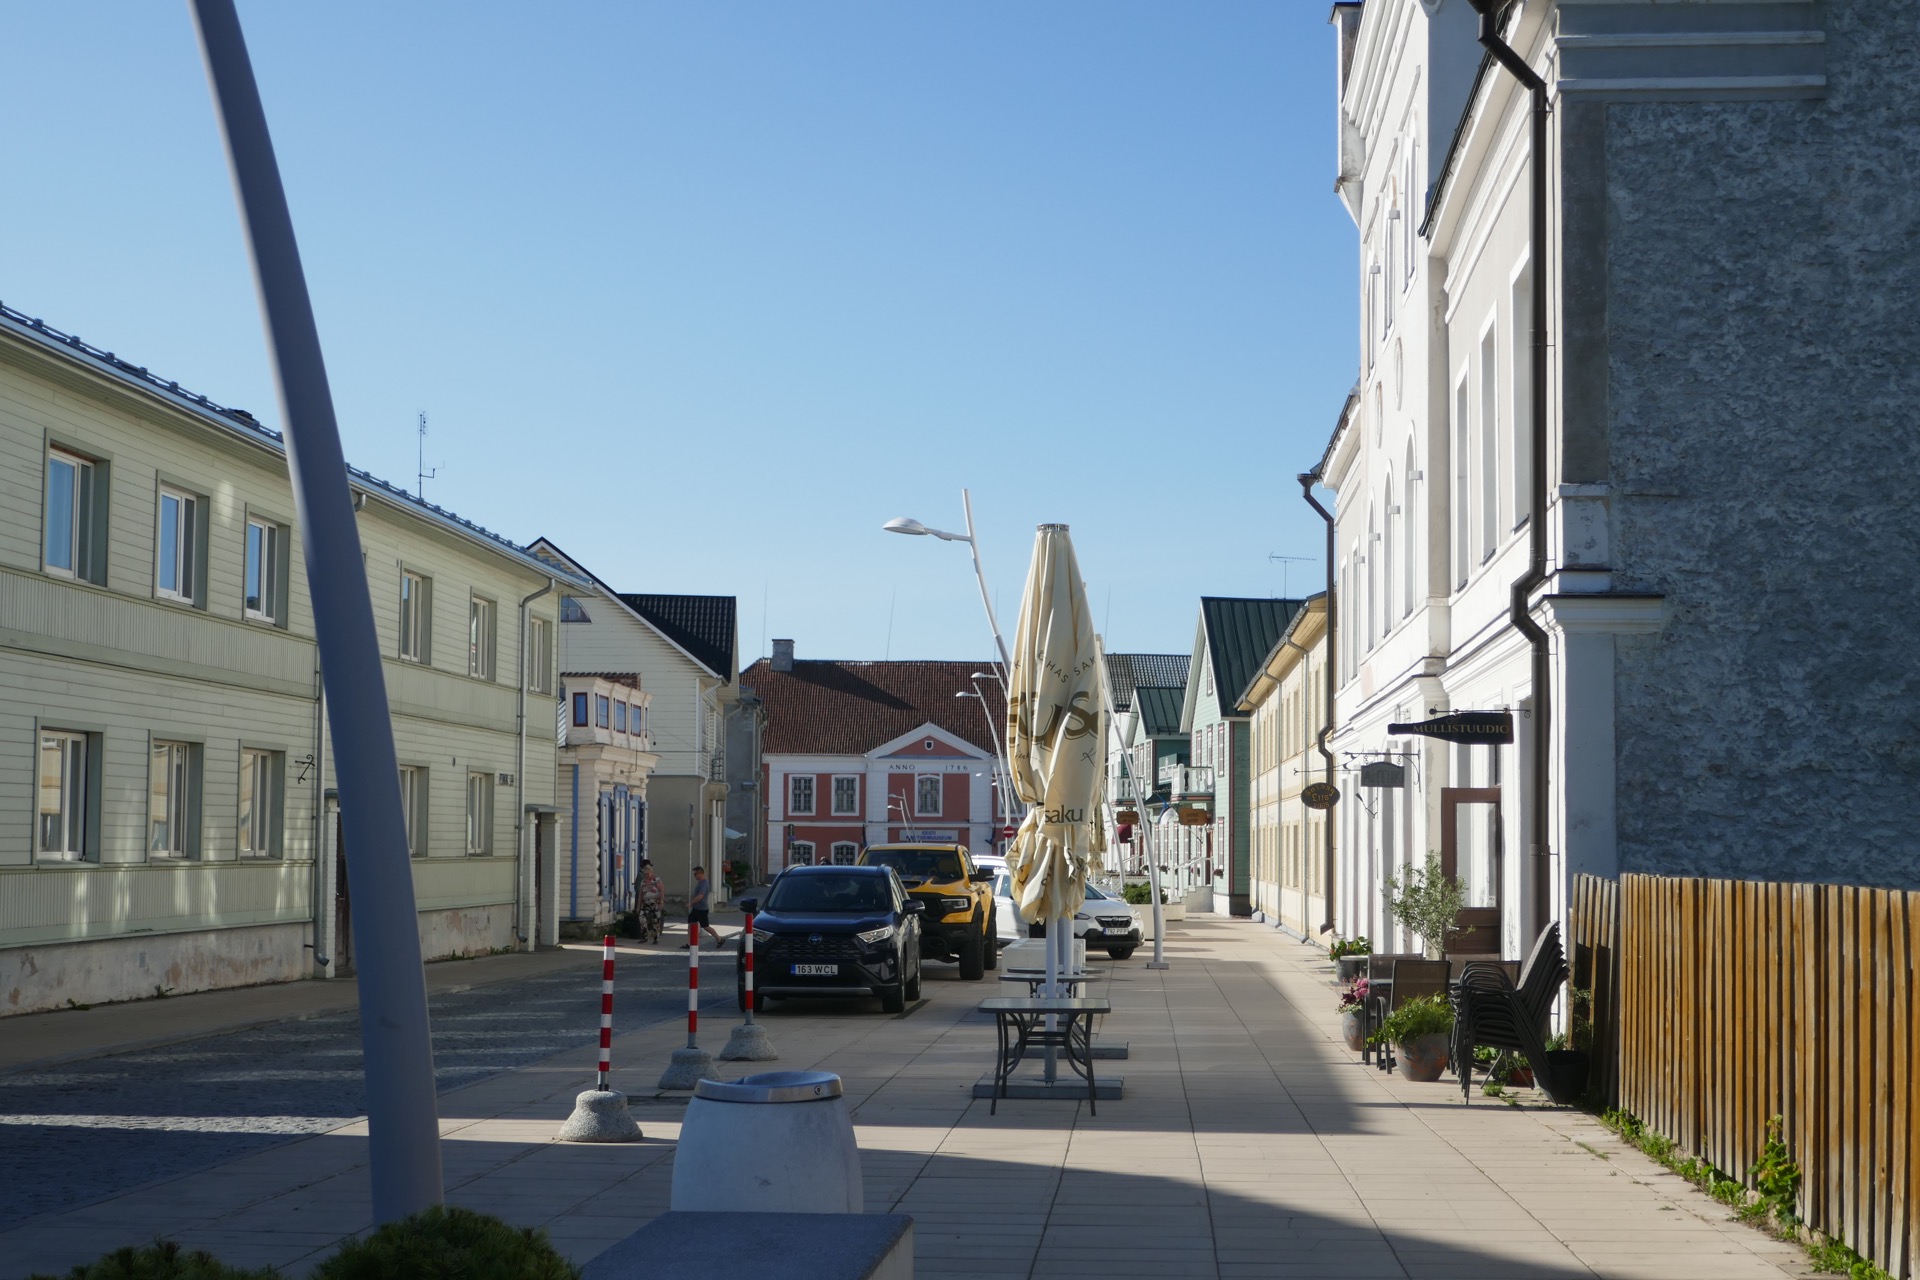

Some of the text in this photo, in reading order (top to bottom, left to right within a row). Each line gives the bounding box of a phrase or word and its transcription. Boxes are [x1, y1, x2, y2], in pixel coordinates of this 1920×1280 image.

[1413, 724, 1510, 734] MULLISTUUDIO
[1044, 805, 1083, 823] saku
[797, 965, 835, 974] 163 WCL
